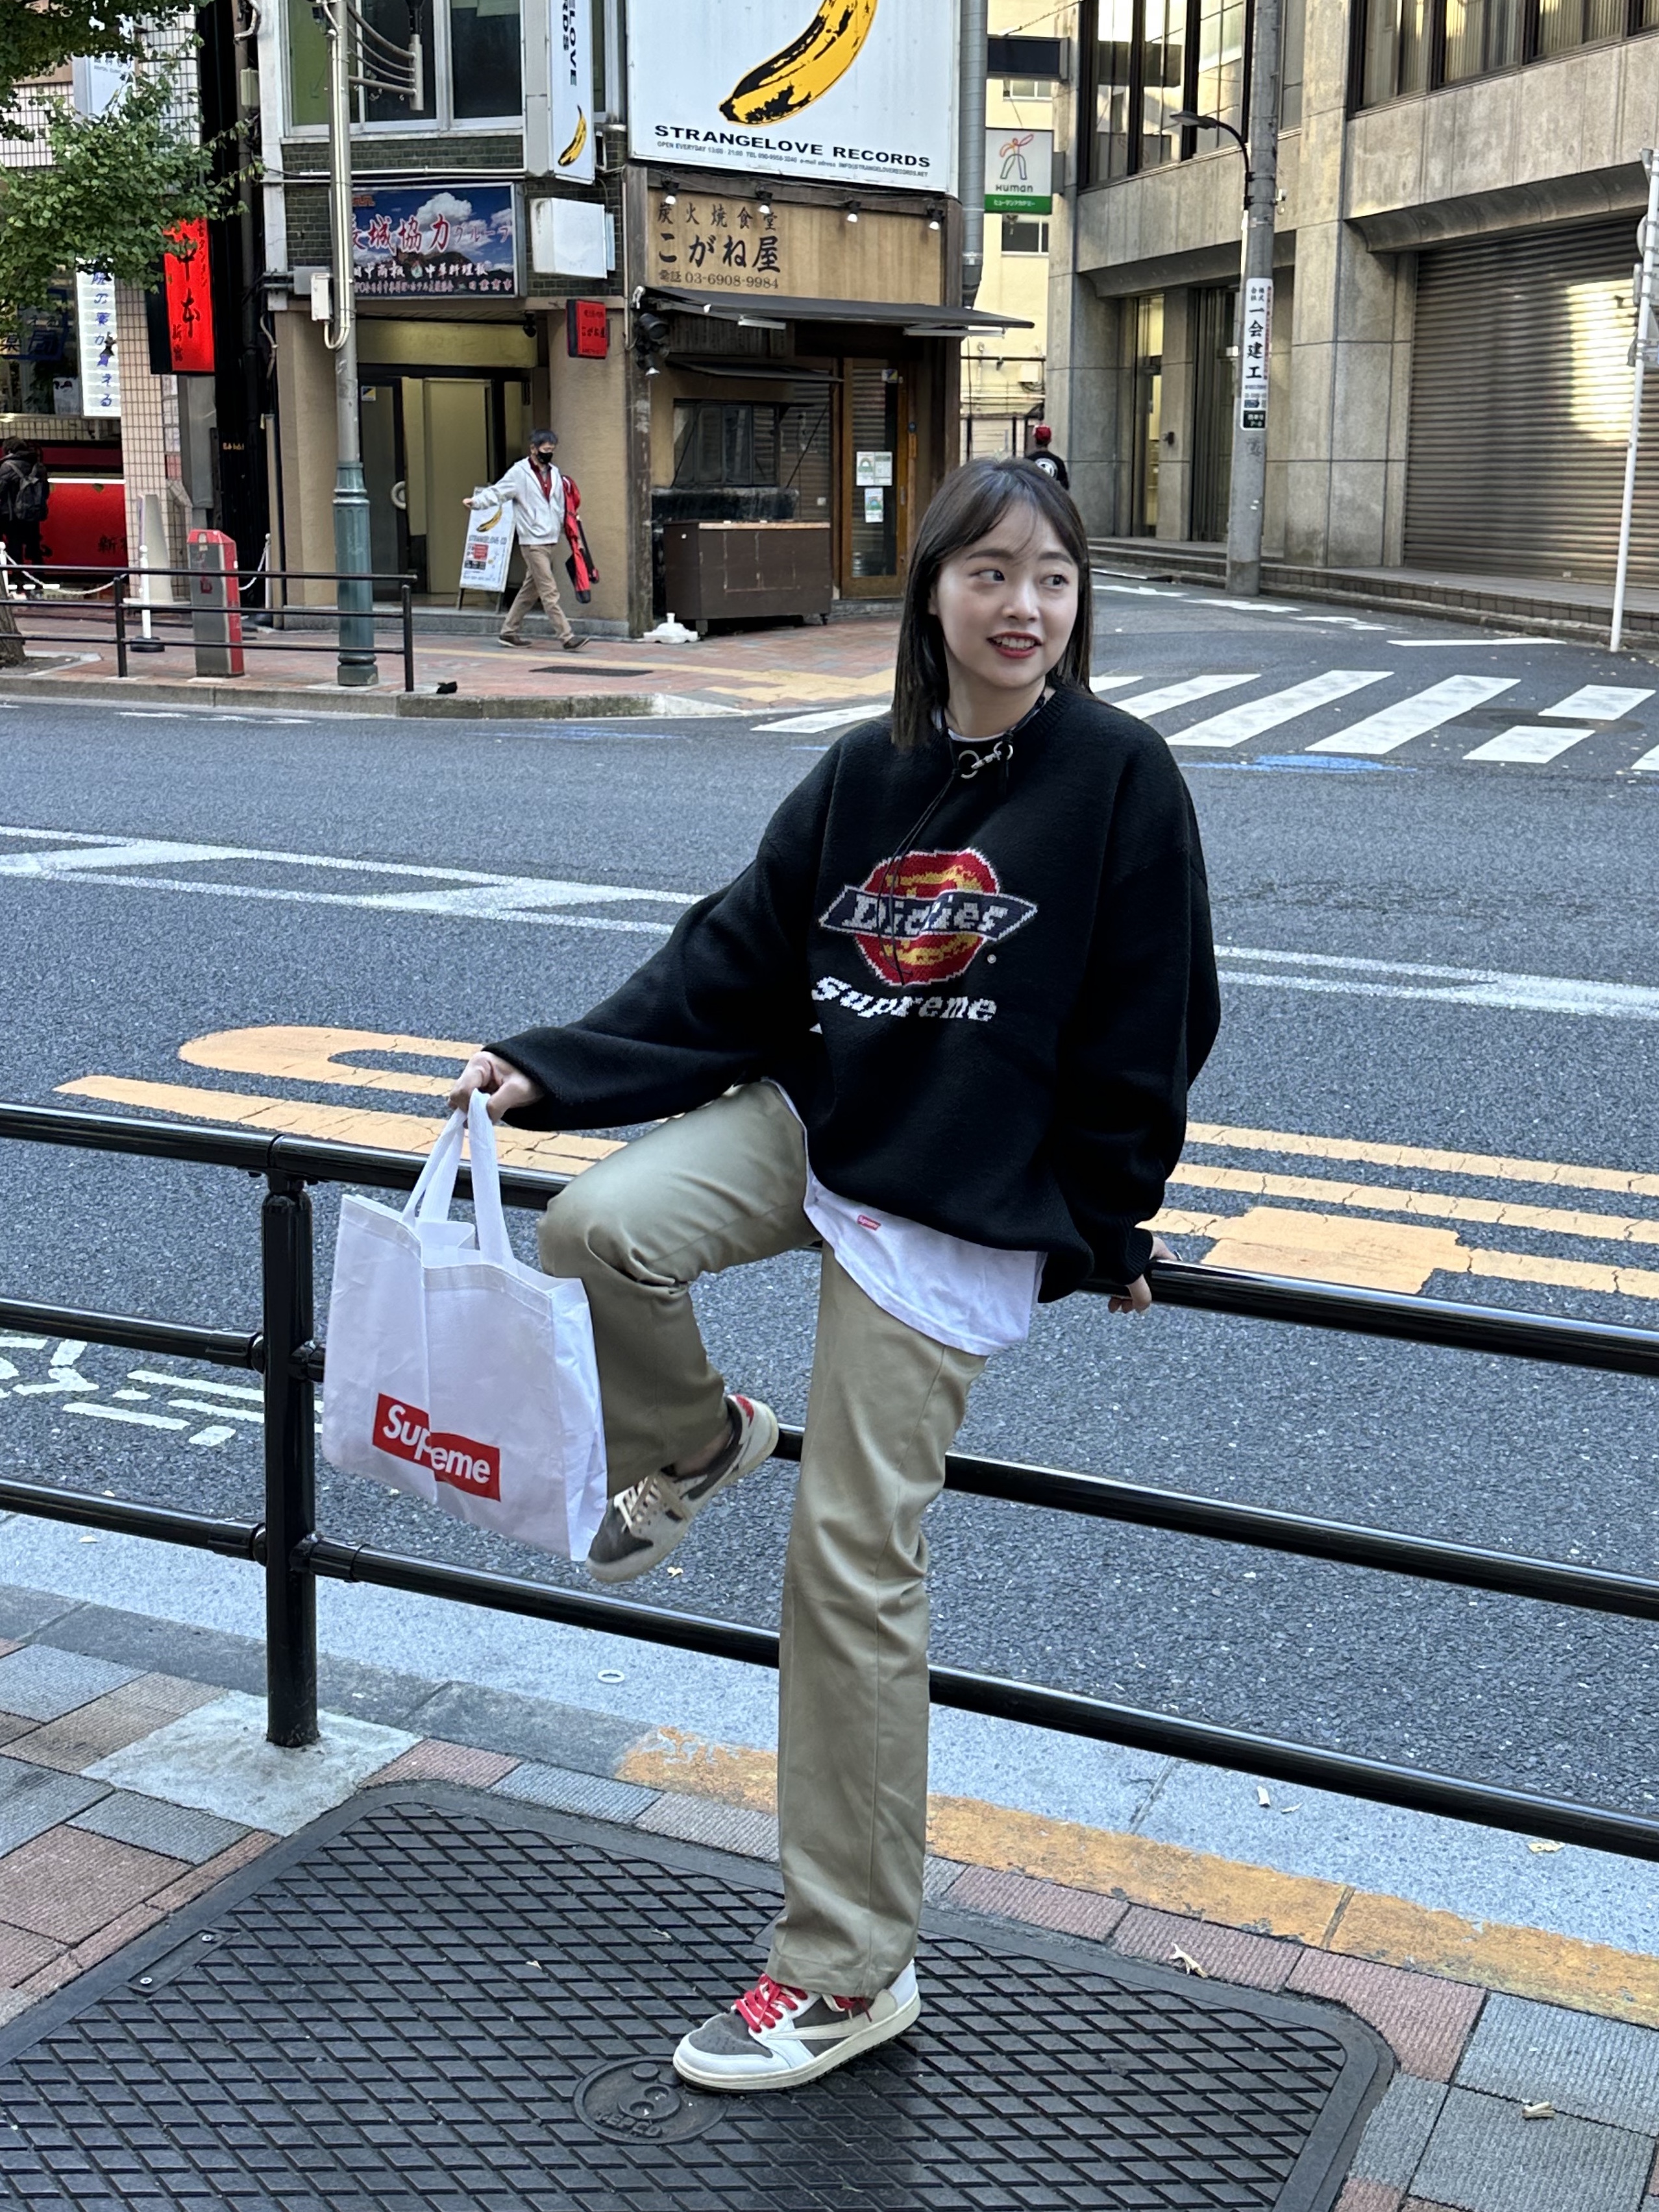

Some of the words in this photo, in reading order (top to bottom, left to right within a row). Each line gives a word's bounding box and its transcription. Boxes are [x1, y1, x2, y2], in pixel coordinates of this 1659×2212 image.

[655, 125, 823, 155] STRANGELOVE
[833, 147, 931, 167] RECORDS
[676, 143, 706, 152] EVERYDAY
[995, 184, 1034, 193] Human
[657, 202, 778, 231] 炭火焼食堂
[658, 232, 780, 273] こがね屋
[685, 271, 779, 289] 03-6908-9984
[842, 892, 1009, 936] Dicies
[811, 976, 998, 1022] Supreme
[382, 1404, 491, 1484] Supeme
